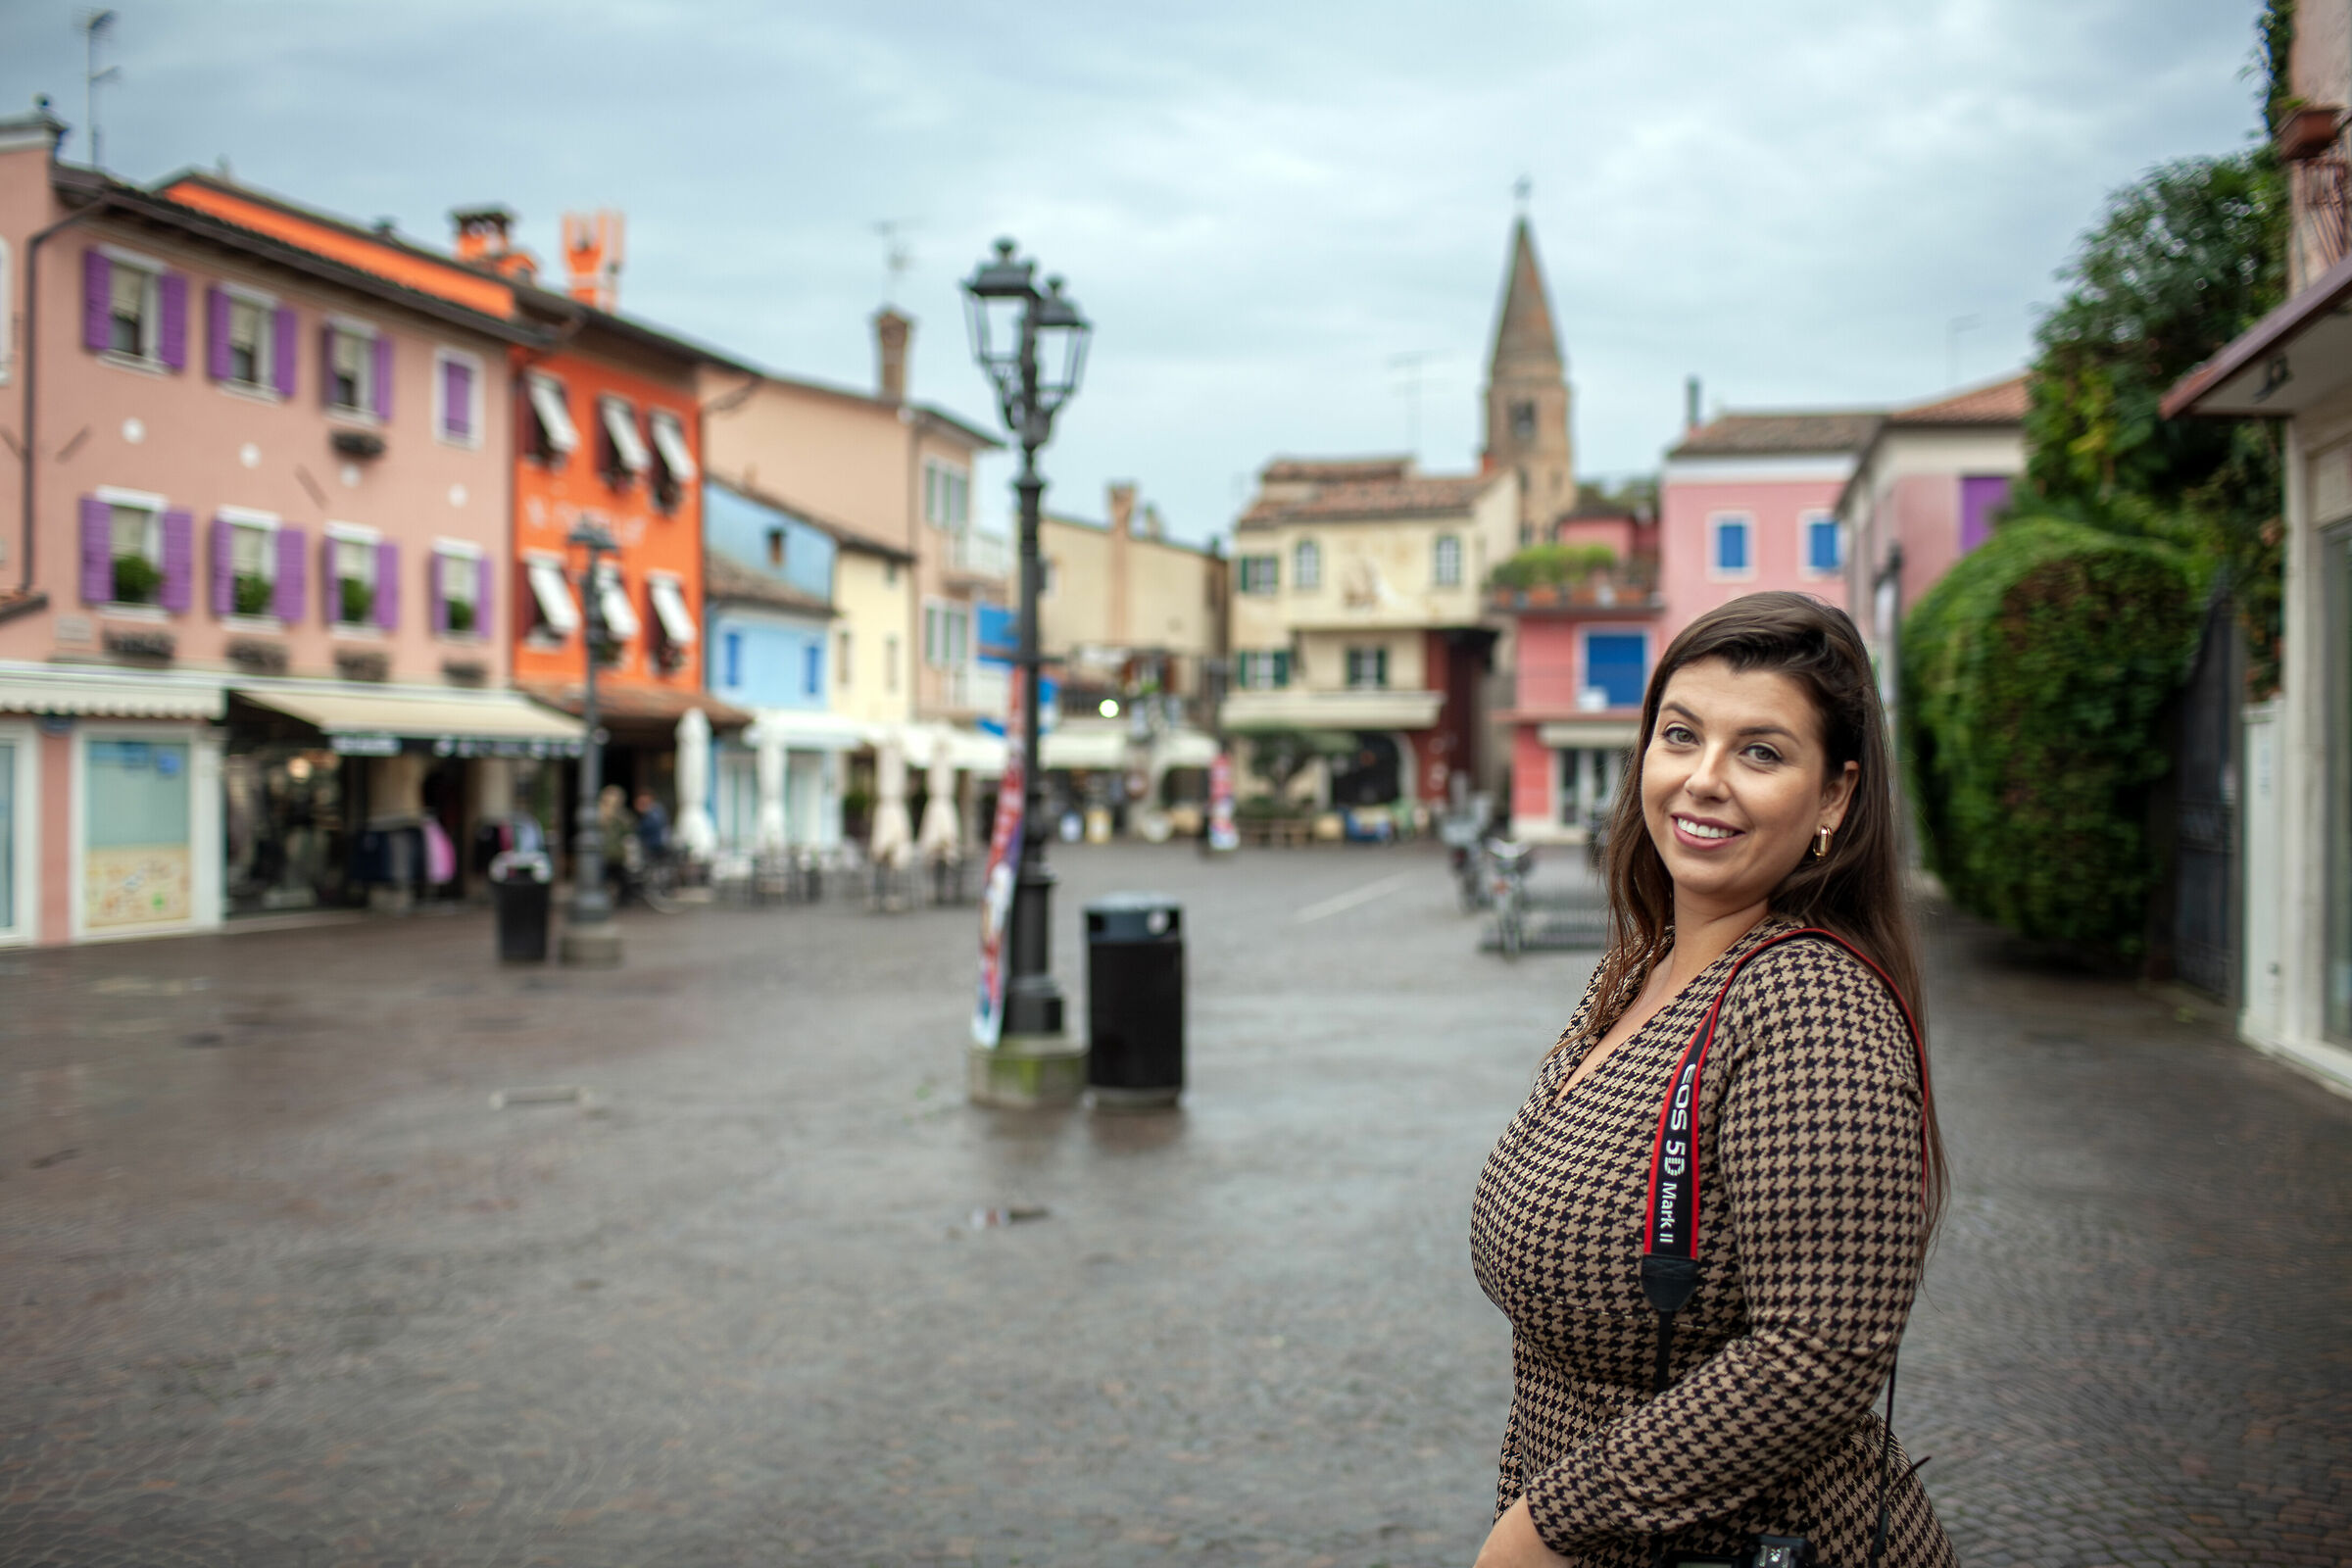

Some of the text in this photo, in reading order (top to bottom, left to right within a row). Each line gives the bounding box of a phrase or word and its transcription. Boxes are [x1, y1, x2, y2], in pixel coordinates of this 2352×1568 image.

[1659, 1063, 1696, 1244] EOS 5D Mark II
